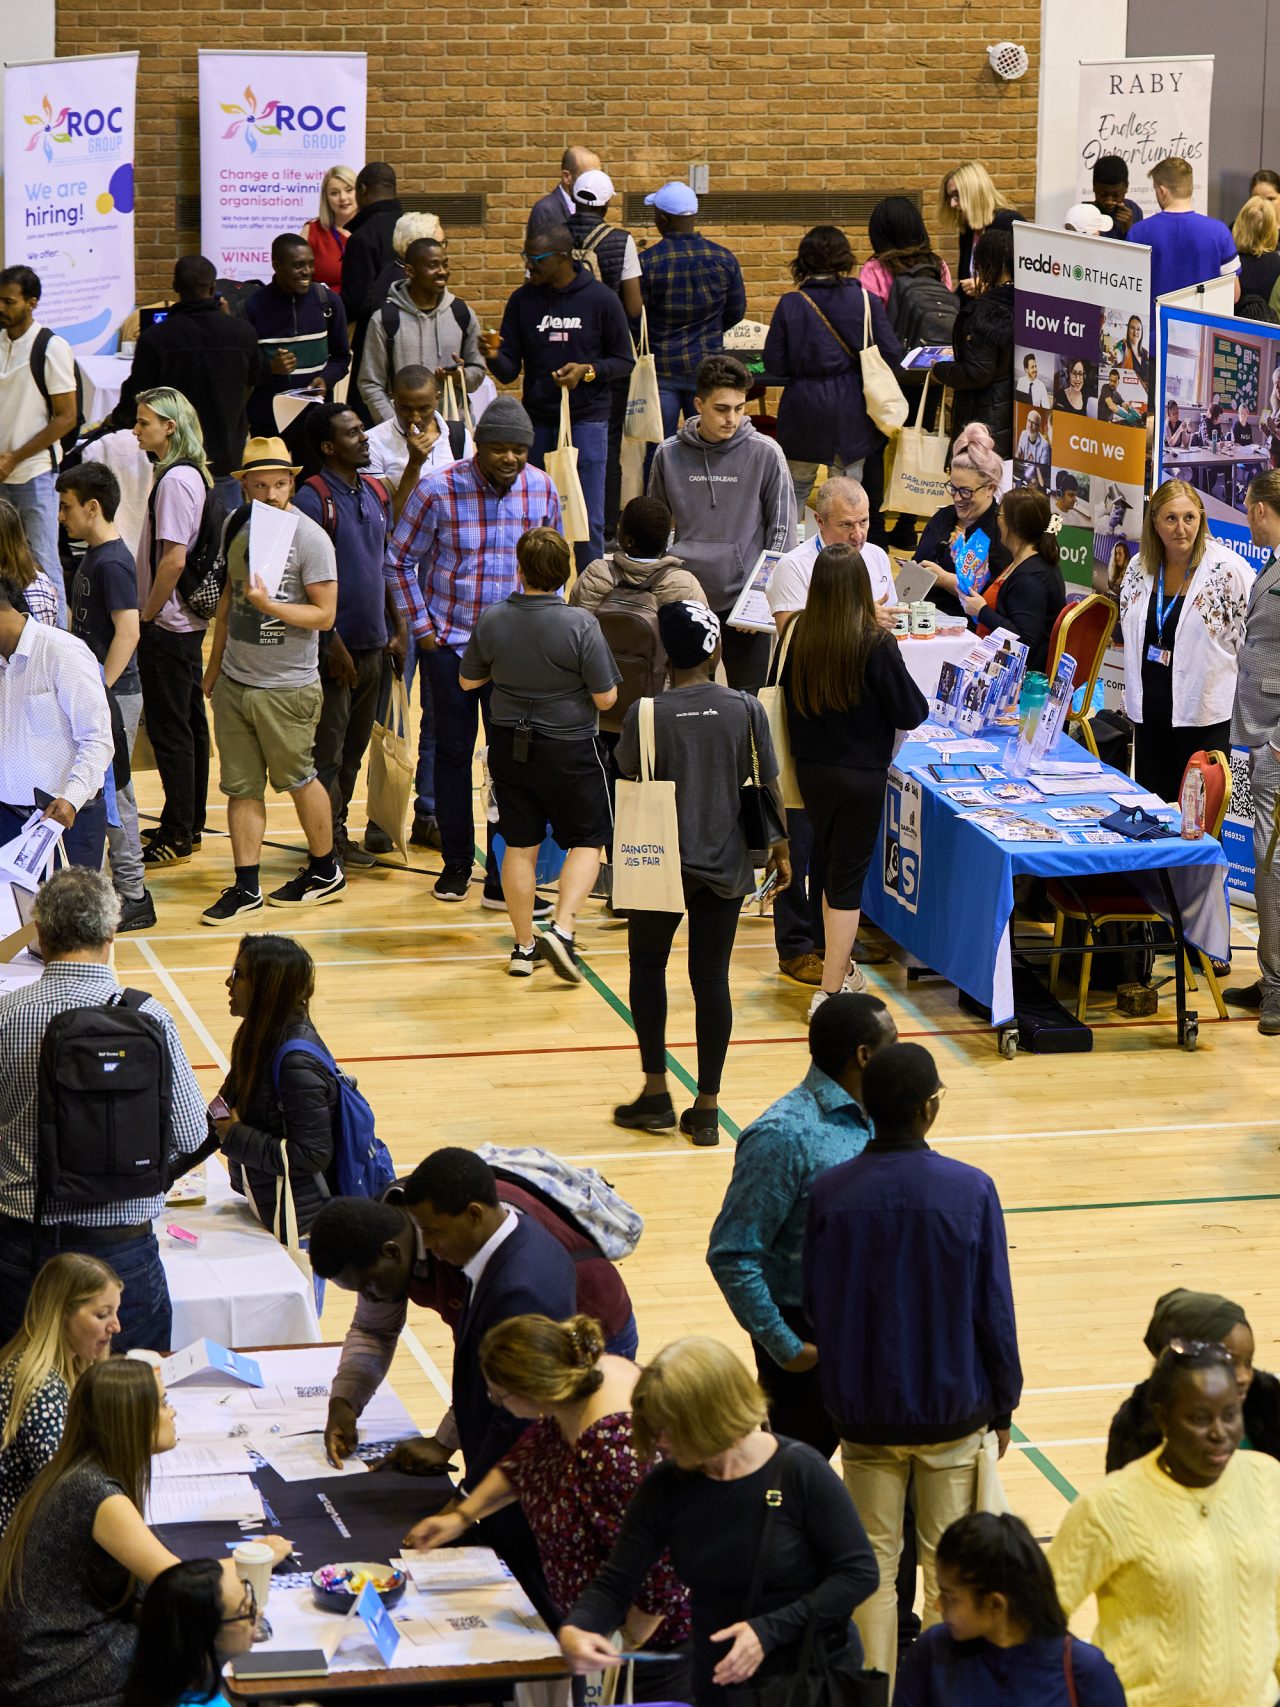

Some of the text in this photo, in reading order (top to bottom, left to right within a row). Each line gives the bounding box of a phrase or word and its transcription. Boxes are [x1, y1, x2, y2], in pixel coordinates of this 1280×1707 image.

[1109, 72, 1184, 95] RABY
[67, 106, 122, 137] ROC
[275, 105, 346, 132] ROC
[1098, 111, 1158, 140] Endless
[88, 135, 123, 153] GROUP
[303, 134, 346, 150] GROUP
[1082, 132, 1203, 171] Opportunities
[220, 169, 302, 183] Change a life
[25, 181, 88, 202] We are
[220, 183, 320, 194] an award-winni
[219, 196, 304, 208] organisation!
[25, 203, 83, 227] hiring!
[221, 252, 272, 263] WINNE
[1019, 253, 1061, 278] redde
[1024, 309, 1086, 338] How far
[1069, 434, 1126, 462] can we
[904, 483, 945, 497] JOBS FAIR
[1059, 545, 1088, 565] ou?
[642, 856, 660, 866] FAIR
